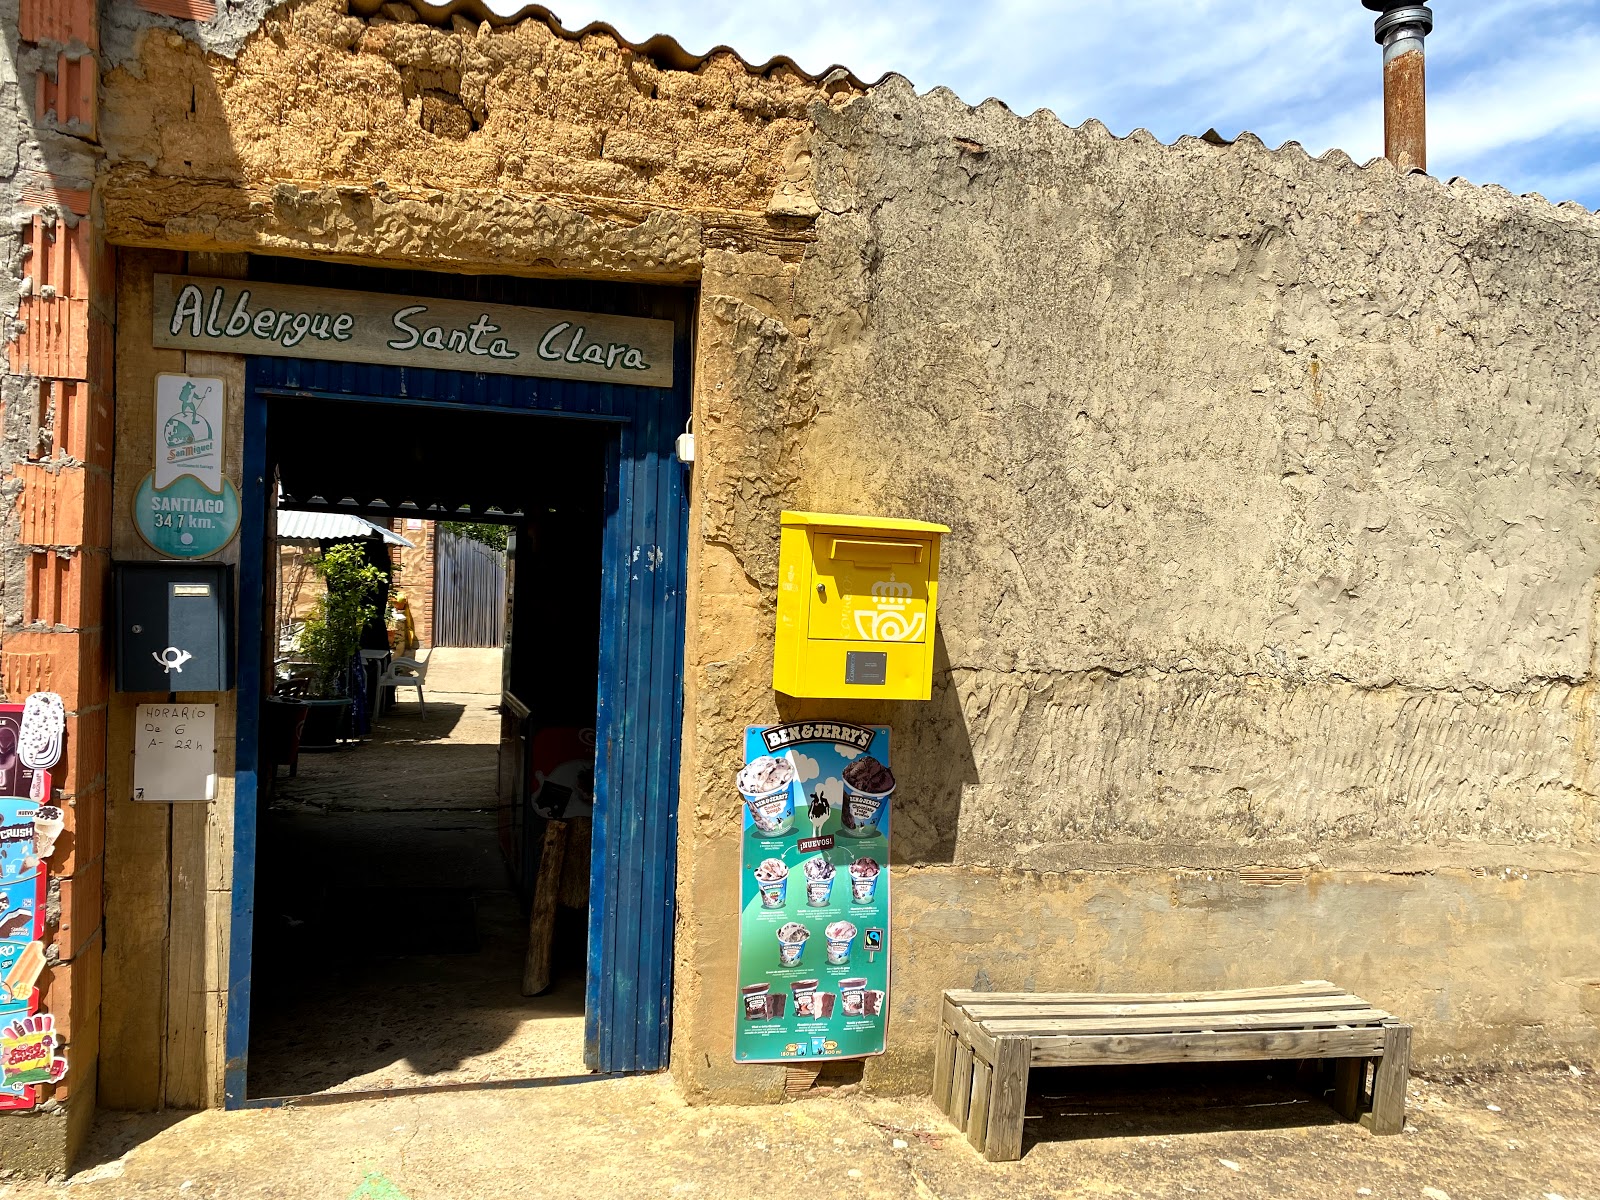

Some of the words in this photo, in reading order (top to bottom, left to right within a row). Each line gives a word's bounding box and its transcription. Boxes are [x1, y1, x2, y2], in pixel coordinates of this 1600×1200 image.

[170, 283, 354, 346] Albergue
[386, 305, 520, 359] Santa
[536, 321, 651, 370] Clara
[151, 497, 224, 514] SANTIAGO
[188, 515, 216, 529] km.
[146, 707, 206, 720] HORARIO
[0, 827, 33, 839] CRUSH
